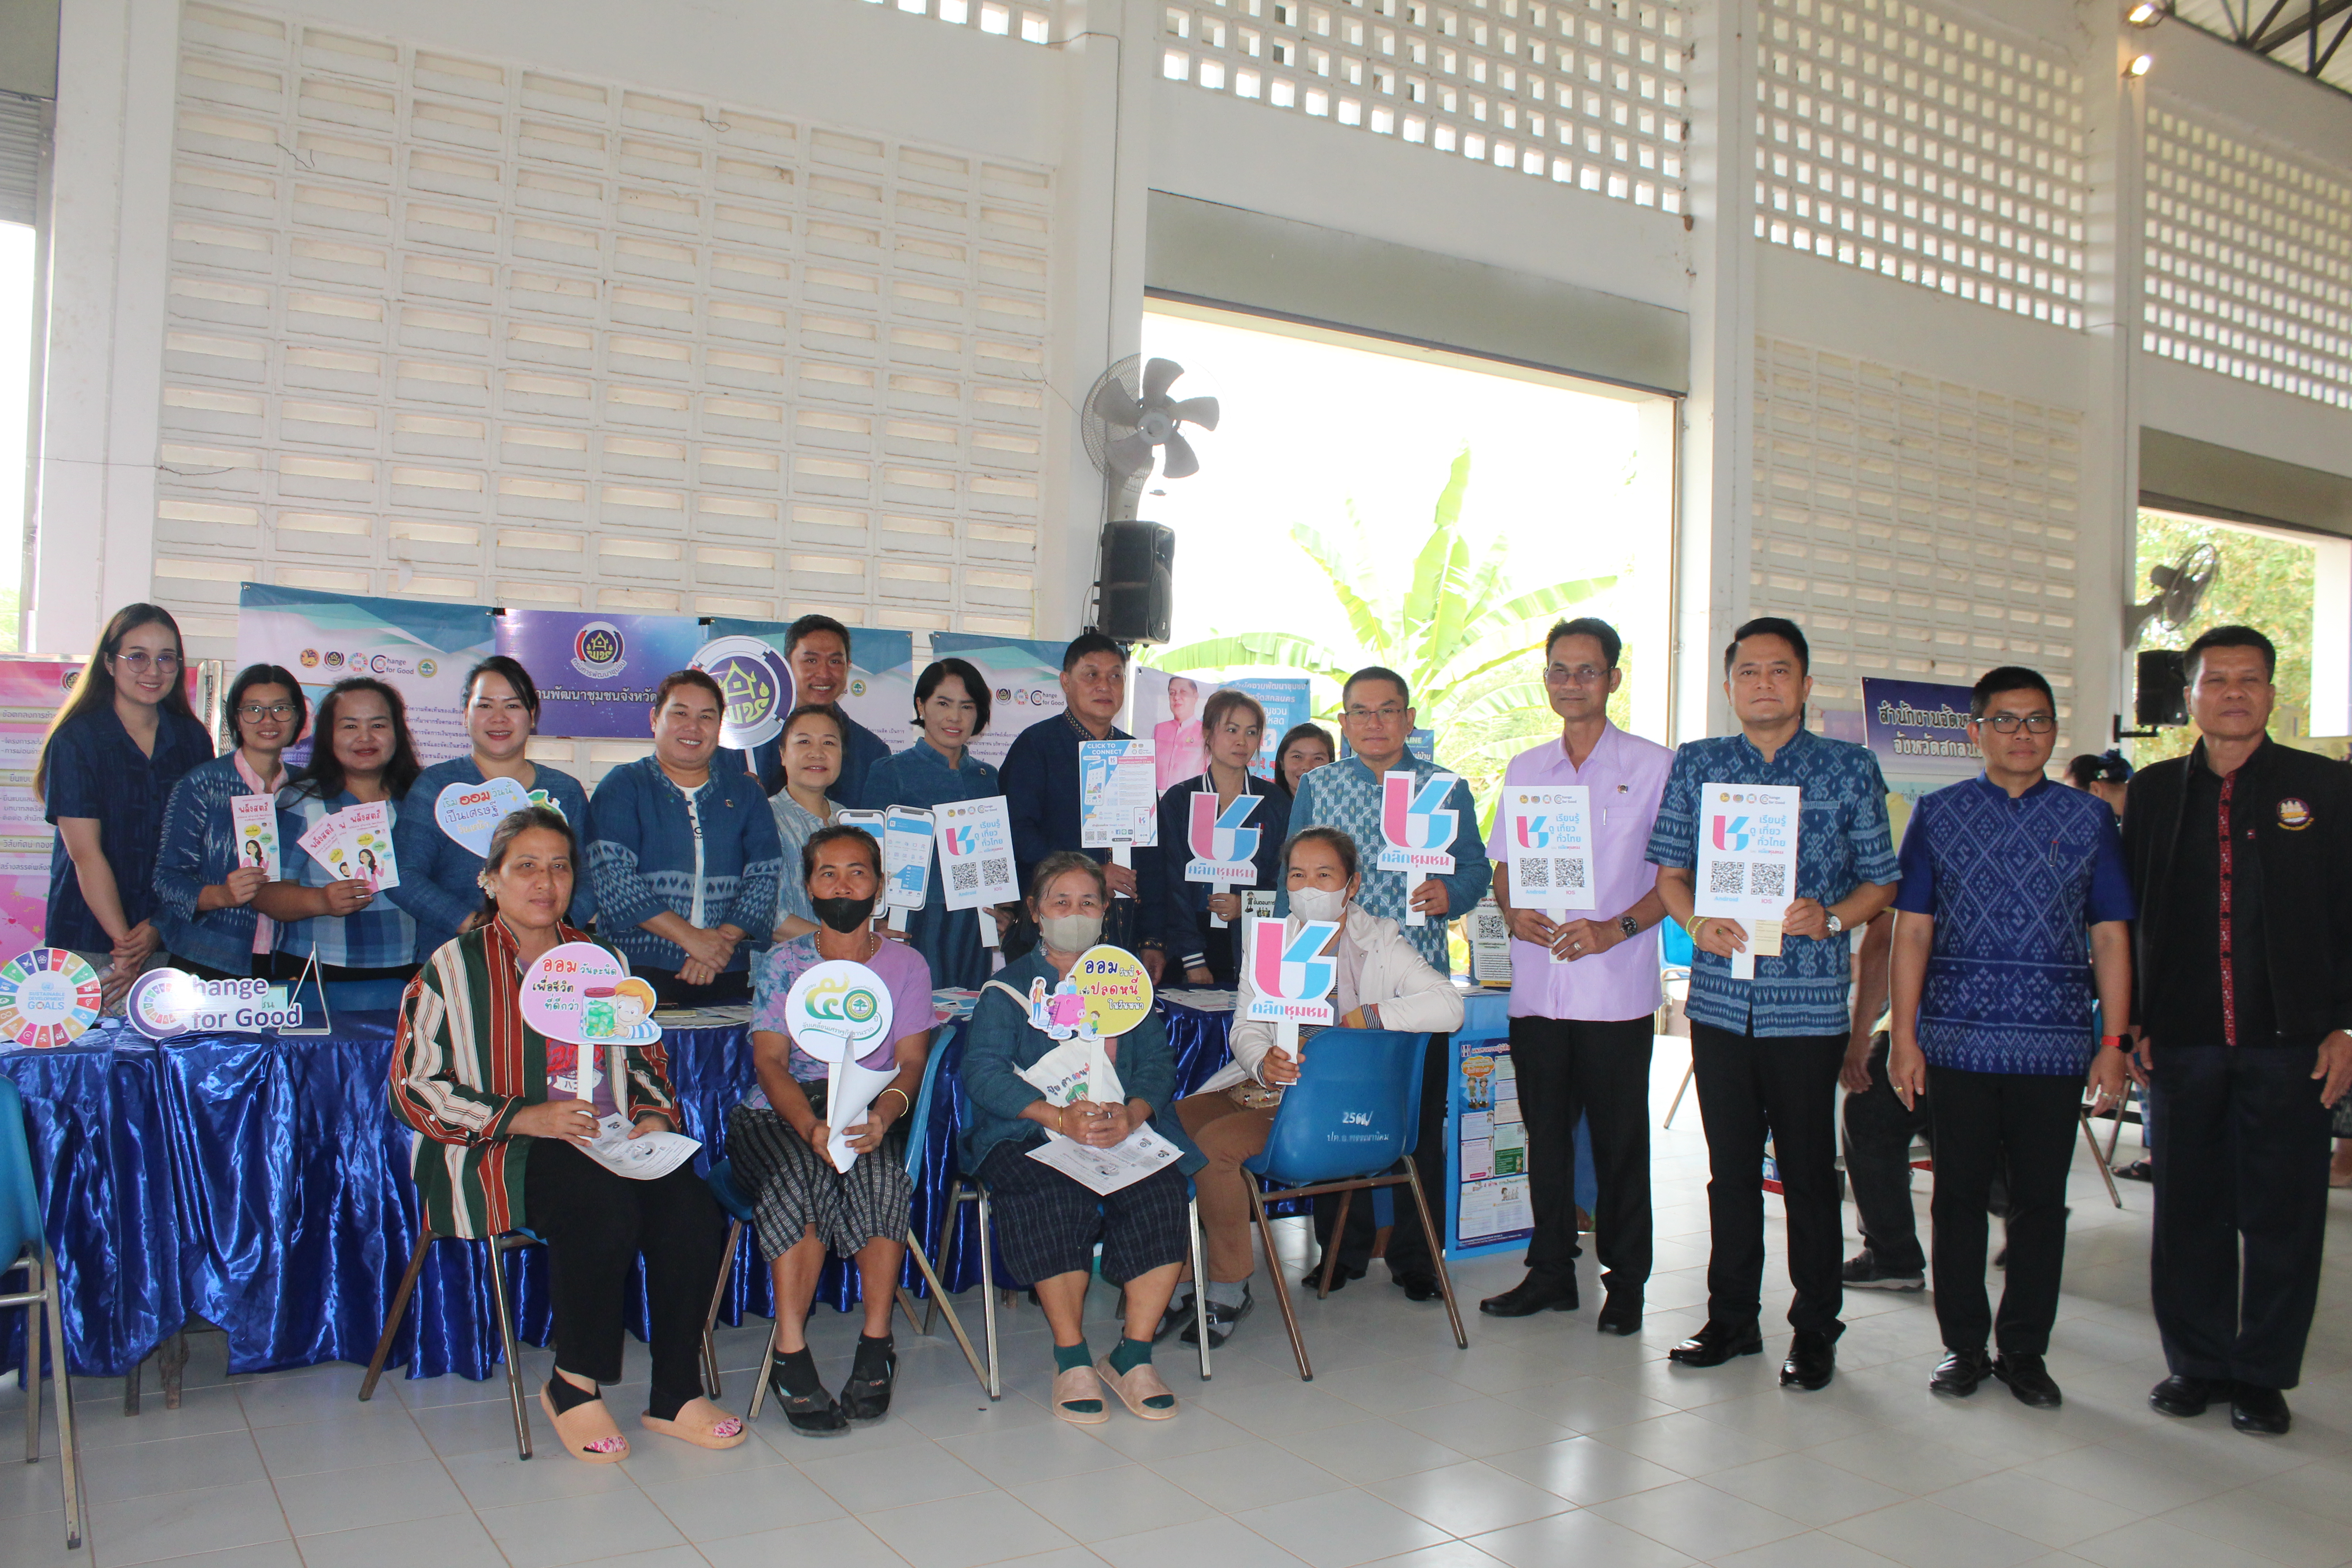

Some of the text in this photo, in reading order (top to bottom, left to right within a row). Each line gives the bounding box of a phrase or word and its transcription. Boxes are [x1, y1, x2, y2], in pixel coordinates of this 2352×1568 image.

[459, 790, 491, 806] ออม
[445, 800, 499, 823] เป็นเศรษฐี
[1556, 813, 1580, 824] เรียนรู้
[980, 818, 1000, 829] เรียนรู้
[1548, 822, 1576, 834] ดู เที่ยว
[1759, 815, 1787, 827] เรียนรู้
[981, 828, 997, 838] เที่ยว
[1750, 823, 1781, 836] ดู เที่ยว
[982, 838, 1003, 847] ทั่วไทย
[1556, 834, 1581, 843] ทั่วไทย
[1758, 836, 1786, 847] ทั่วไทย
[1382, 850, 1450, 868] คลิกชุมชน
[1188, 862, 1254, 880] คลิกชุมชน
[542, 958, 617, 975] ออม วันละนิด
[1084, 960, 1134, 977] ออม วันนี้
[532, 975, 574, 993] เพื่อชีวิต
[1090, 969, 1143, 996] ปลดหนี้
[27, 1001, 65, 1010] GOALS
[544, 993, 580, 1011] ที่ดีกว่า
[1107, 996, 1144, 1010] ในวันหน้า
[191, 1004, 301, 1029] for Good
[1252, 1000, 1328, 1020] คลิกชุมชน
